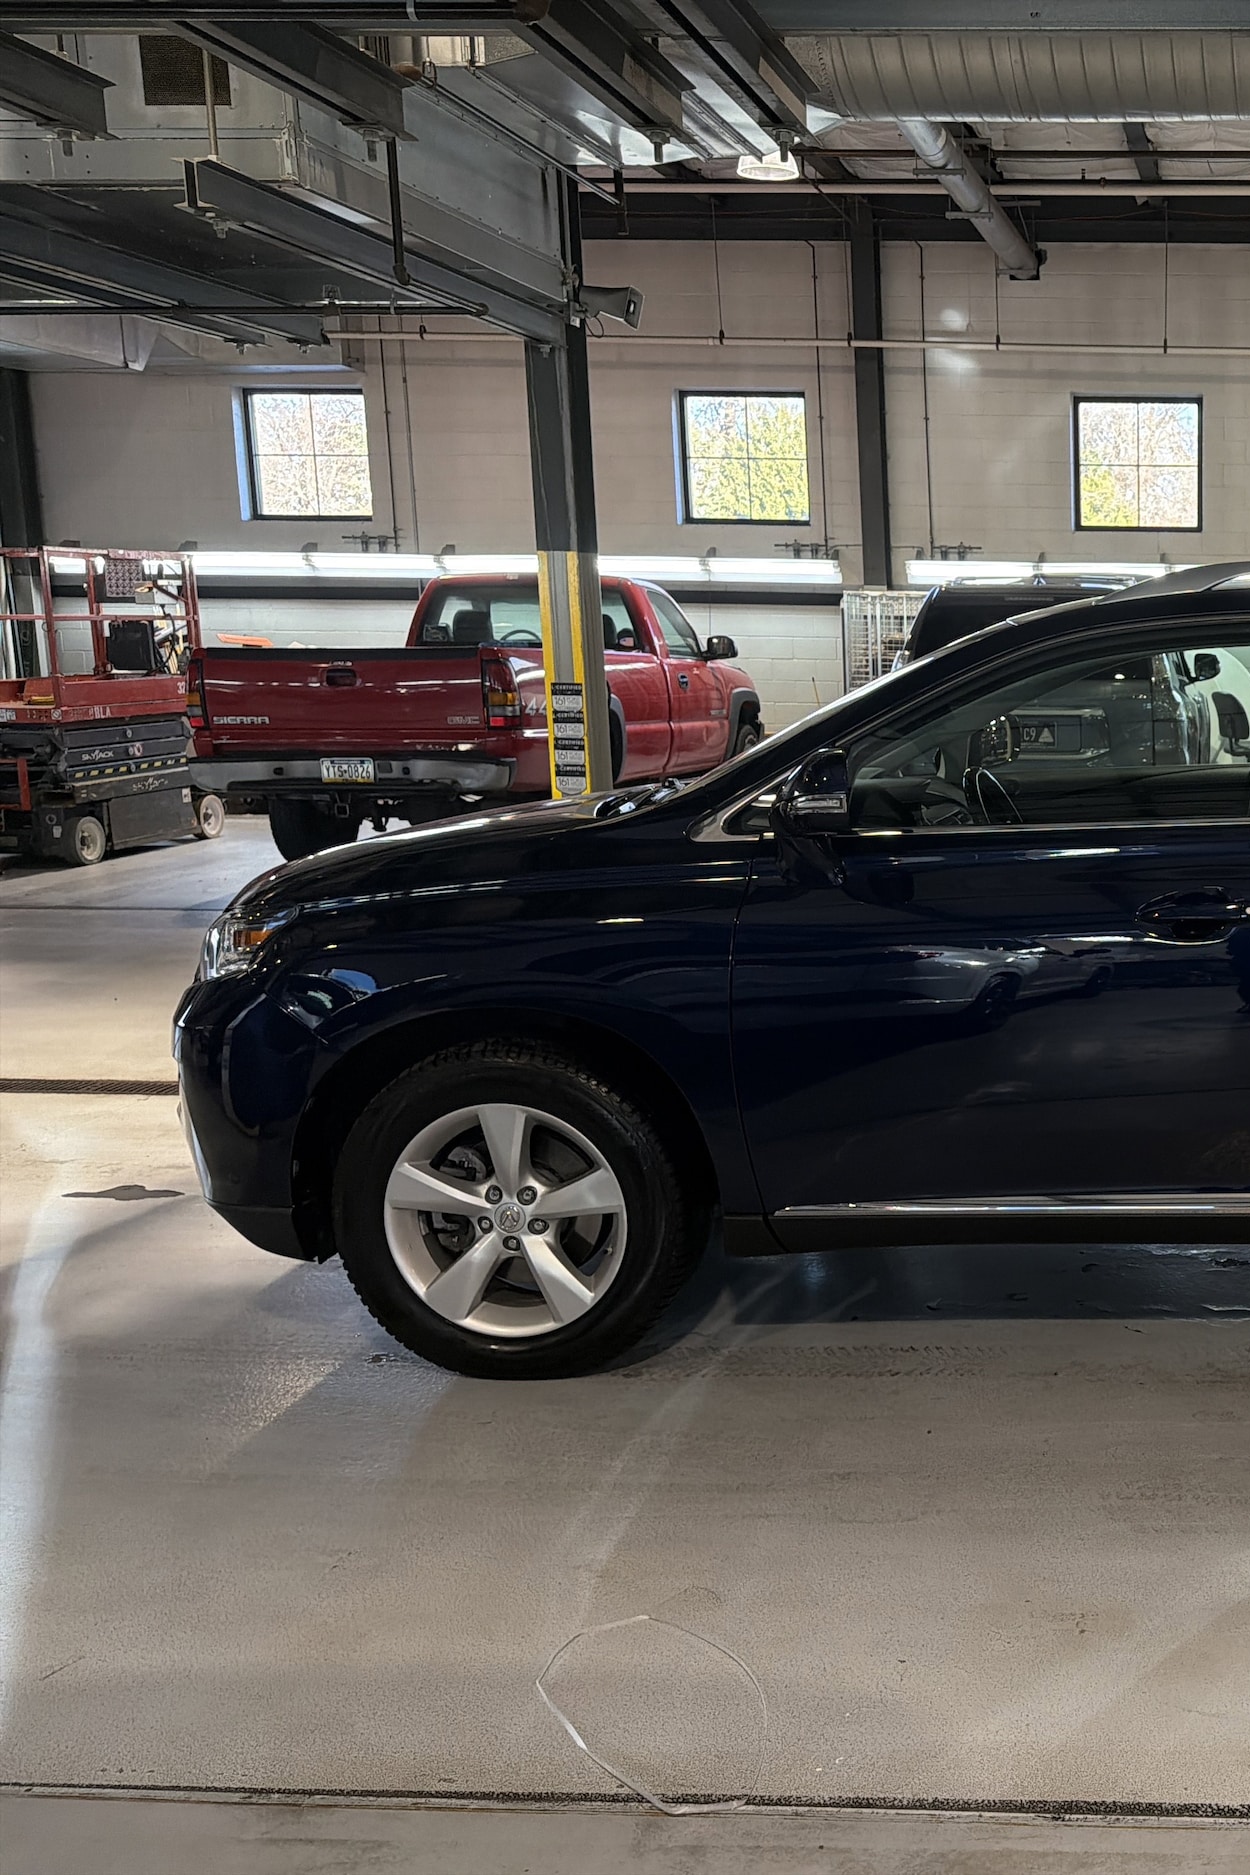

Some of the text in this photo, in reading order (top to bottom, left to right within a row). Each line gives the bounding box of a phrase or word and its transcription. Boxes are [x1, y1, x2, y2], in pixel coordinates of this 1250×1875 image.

[554, 696, 566, 705] 161
[213, 716, 270, 725] SIERRA
[447, 716, 480, 725] GMC
[556, 724, 568, 733] 161
[81, 750, 115, 760] SKYJACK
[557, 751, 569, 760] 161
[558, 777, 570, 786] 161
